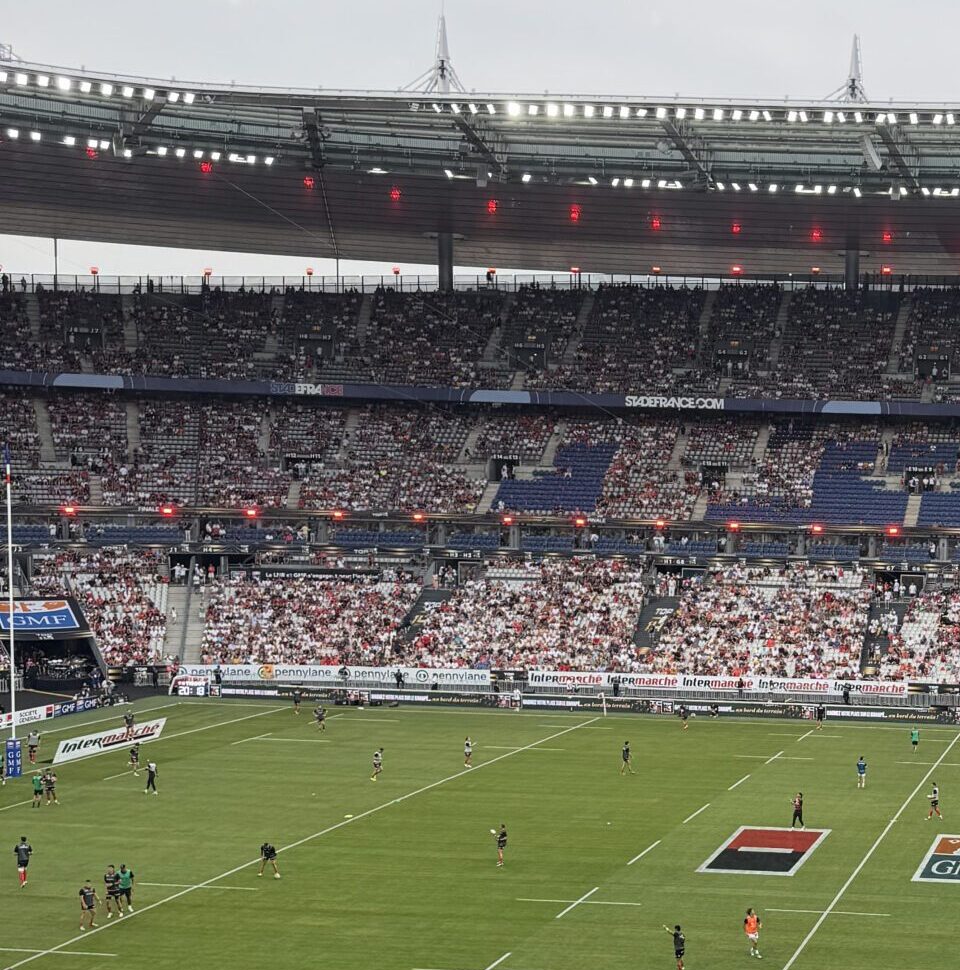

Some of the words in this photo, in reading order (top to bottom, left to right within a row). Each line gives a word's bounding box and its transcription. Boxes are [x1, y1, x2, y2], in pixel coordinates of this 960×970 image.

[625, 395, 724, 409] STADEFRANCE.COM
[8, 614, 67, 626] GMF
[275, 667, 331, 679] pennylane
[355, 668, 409, 680] pennylae
[61, 703, 76, 714] GMF
